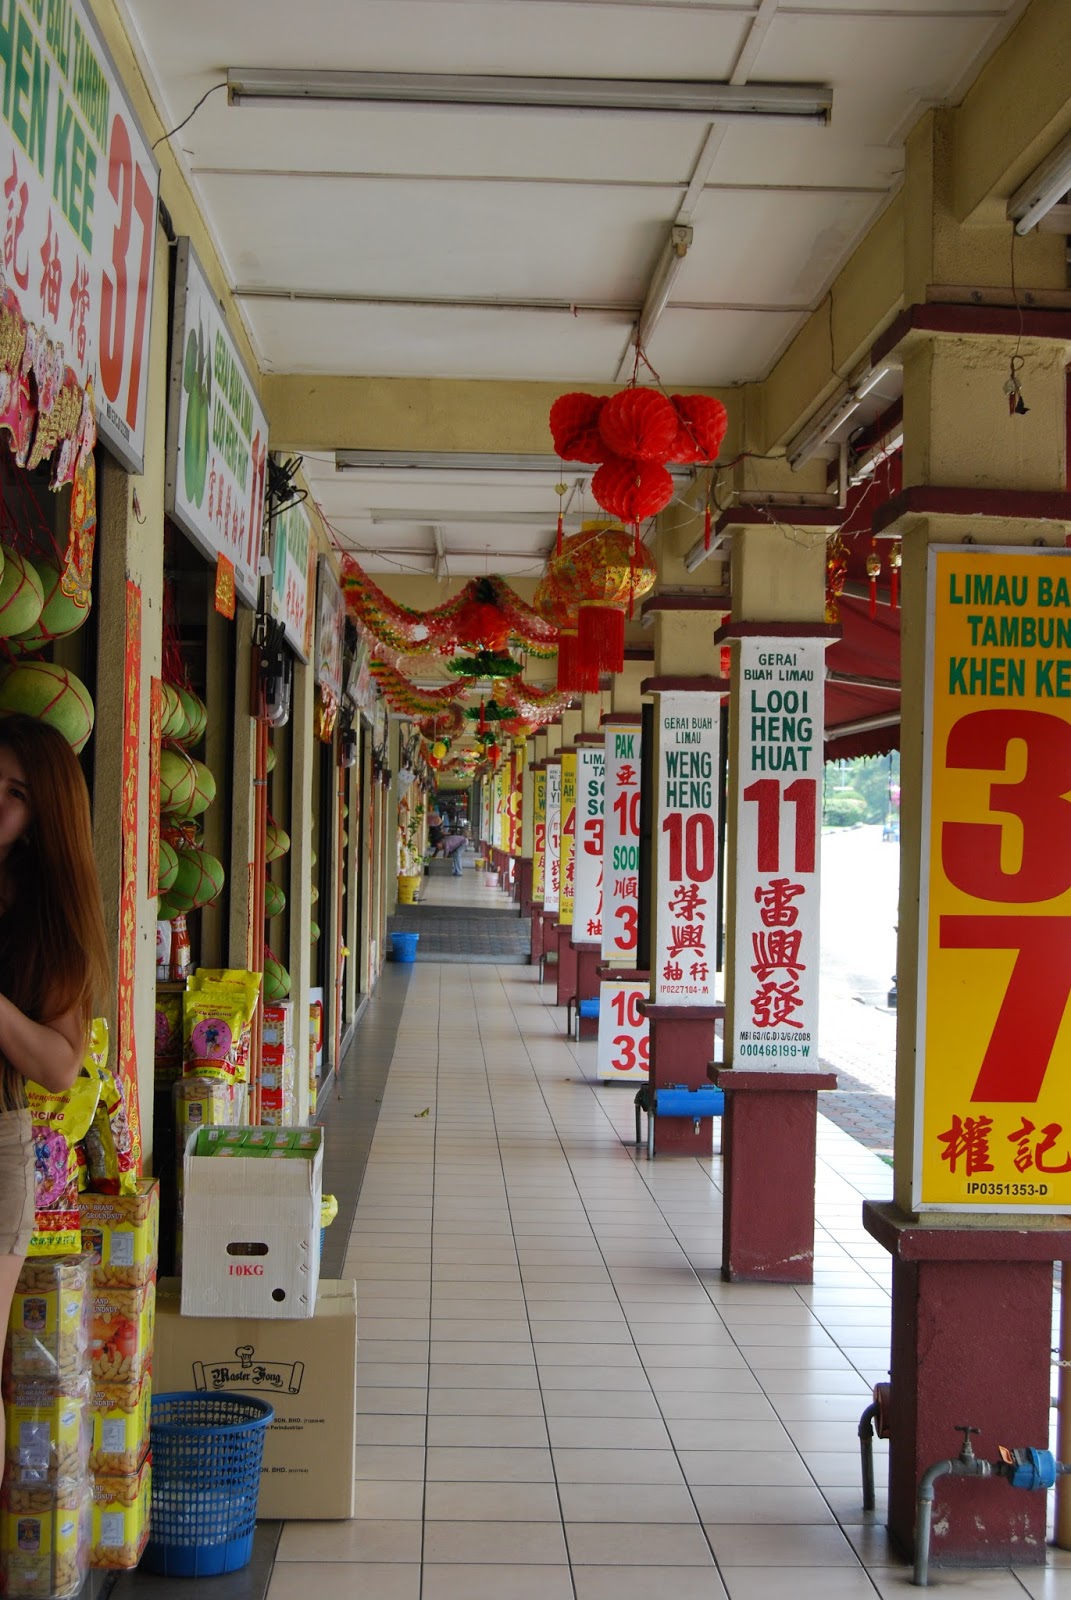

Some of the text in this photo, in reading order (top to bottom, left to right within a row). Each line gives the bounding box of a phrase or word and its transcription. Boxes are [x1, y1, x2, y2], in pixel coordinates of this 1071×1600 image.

[53, 83, 98, 256] KEE
[100, 113, 154, 432] 37
[247, 428, 266, 576] 11
[949, 573, 1028, 607] LIMAU
[967, 615, 1071, 649] TAMBUN
[758, 653, 797, 666] GERAI
[778, 670, 814, 682] LIMAU
[949, 657, 1071, 698] KHEN KE
[750, 689, 808, 714] LOOI
[664, 717, 712, 730] GERAI BUAH
[750, 716, 813, 742] HENG
[615, 734, 635, 759] PAK
[675, 732, 701, 744] LIMAU
[666, 751, 712, 779] WENG
[750, 745, 813, 771] HUAT
[666, 781, 712, 809] HENG
[743, 778, 817, 873] 11
[662, 812, 715, 882] 10
[612, 876, 639, 900] 順
[613, 905, 639, 951] 3
[749, 877, 807, 1029] 雷興發
[611, 990, 646, 1028] 10
[740, 1044, 811, 1058] 000468199-W
[966, 1182, 1049, 1196] IP0351353-D
[85, 1212, 123, 1220] GROUNDNUT
[228, 1264, 264, 1276] 10KG
[211, 1367, 251, 1389] Master
